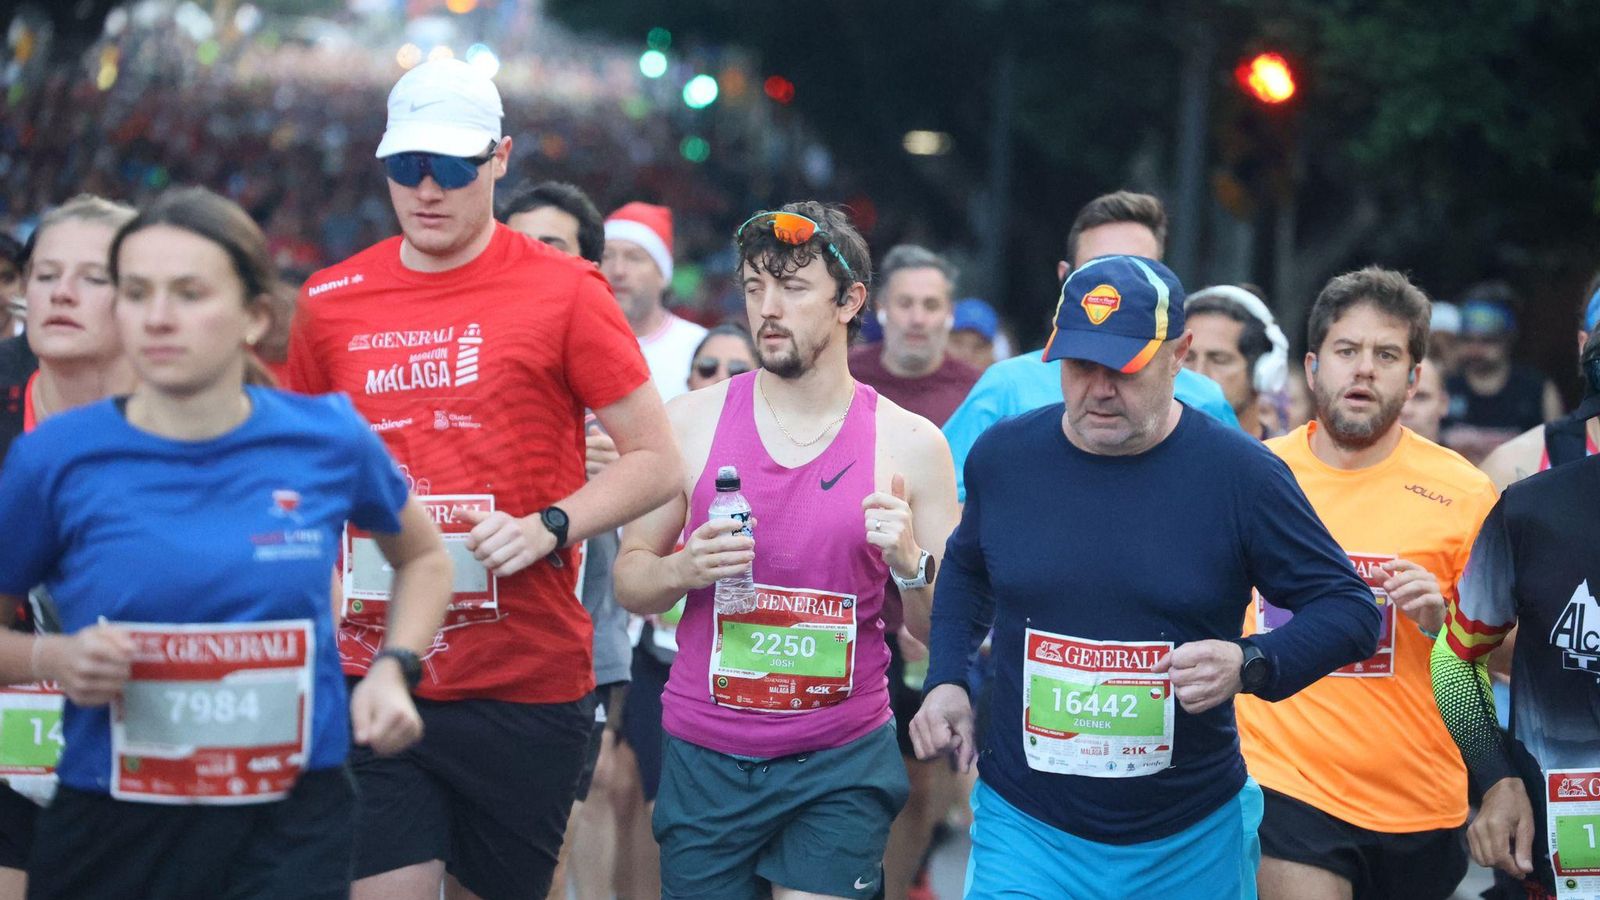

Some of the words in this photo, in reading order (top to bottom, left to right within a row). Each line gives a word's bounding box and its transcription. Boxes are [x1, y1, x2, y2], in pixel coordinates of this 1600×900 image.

[371, 326, 454, 349] GENERALI
[365, 361, 450, 395] MÁLAGA
[756, 592, 844, 618] GENERALI
[166, 632, 297, 664] GENERALI
[750, 631, 816, 658] 2250
[1064, 645, 1160, 669] GENERALI
[770, 658, 795, 668] JOSH
[805, 685, 831, 695] 42K
[1051, 687, 1138, 718] 16442
[163, 688, 260, 723] 7984
[1073, 718, 1112, 729] ZDENEK
[1122, 746, 1147, 755] 21K
